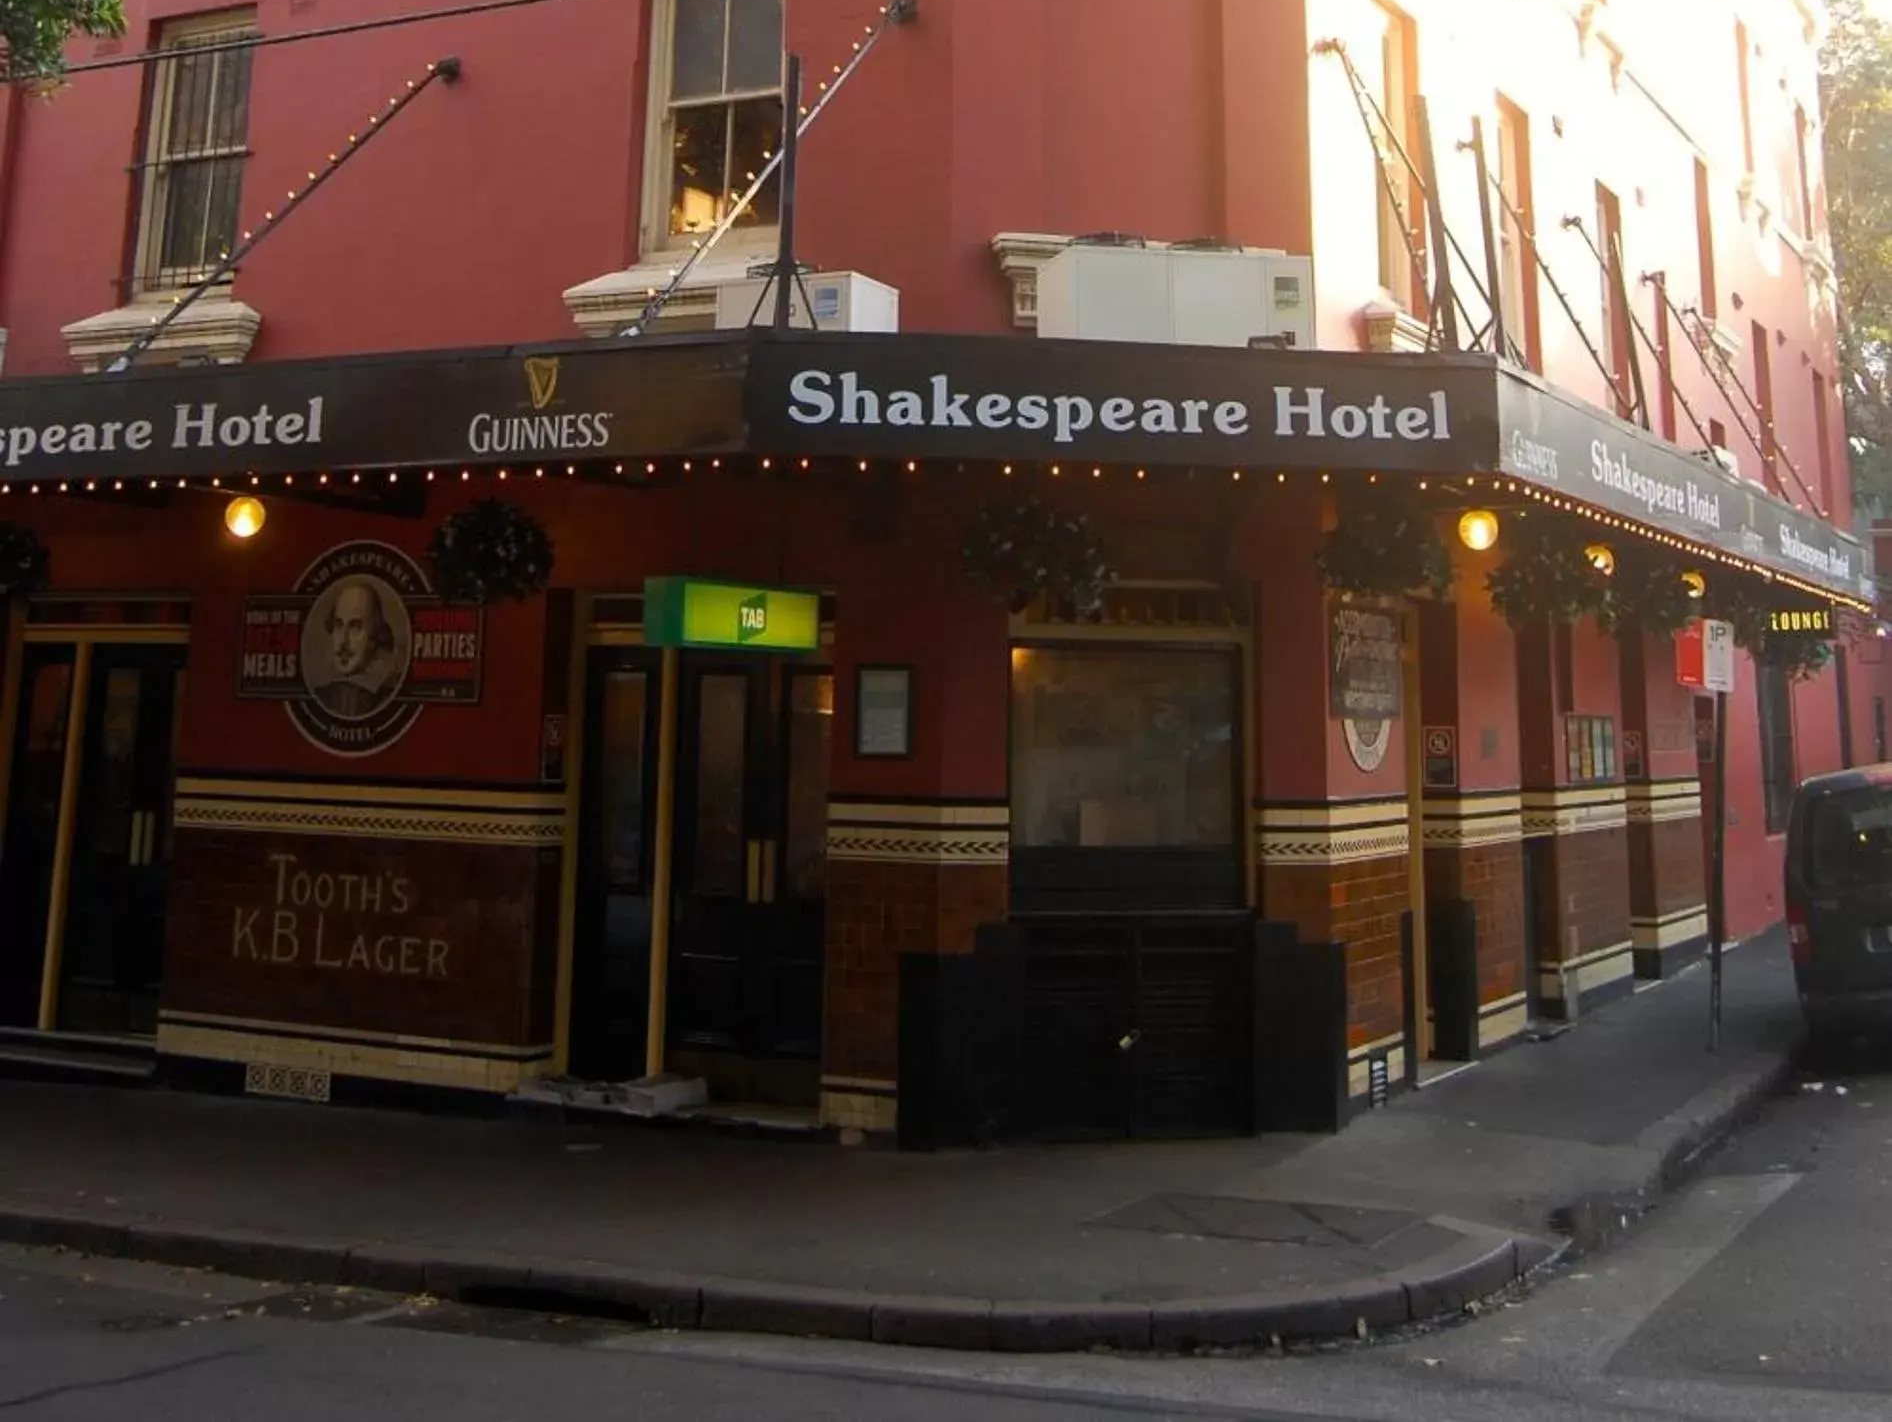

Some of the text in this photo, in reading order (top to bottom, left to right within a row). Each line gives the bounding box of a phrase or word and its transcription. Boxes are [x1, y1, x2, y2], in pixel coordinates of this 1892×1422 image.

[788, 370, 1451, 442] Shakespeare Hotel
[0, 396, 323, 466] peare Hotel
[468, 412, 610, 453] GUINNESS
[1591, 439, 1720, 529] Shakespeare Hotel
[741, 607, 765, 629] TAB
[1710, 625, 1727, 642] 1P
[1770, 611, 1830, 631] LOUNGE
[243, 653, 298, 679] MEALS
[414, 633, 476, 659] PARTIES
[268, 853, 409, 914] TOOTH'S
[313, 911, 449, 976] LAGER
